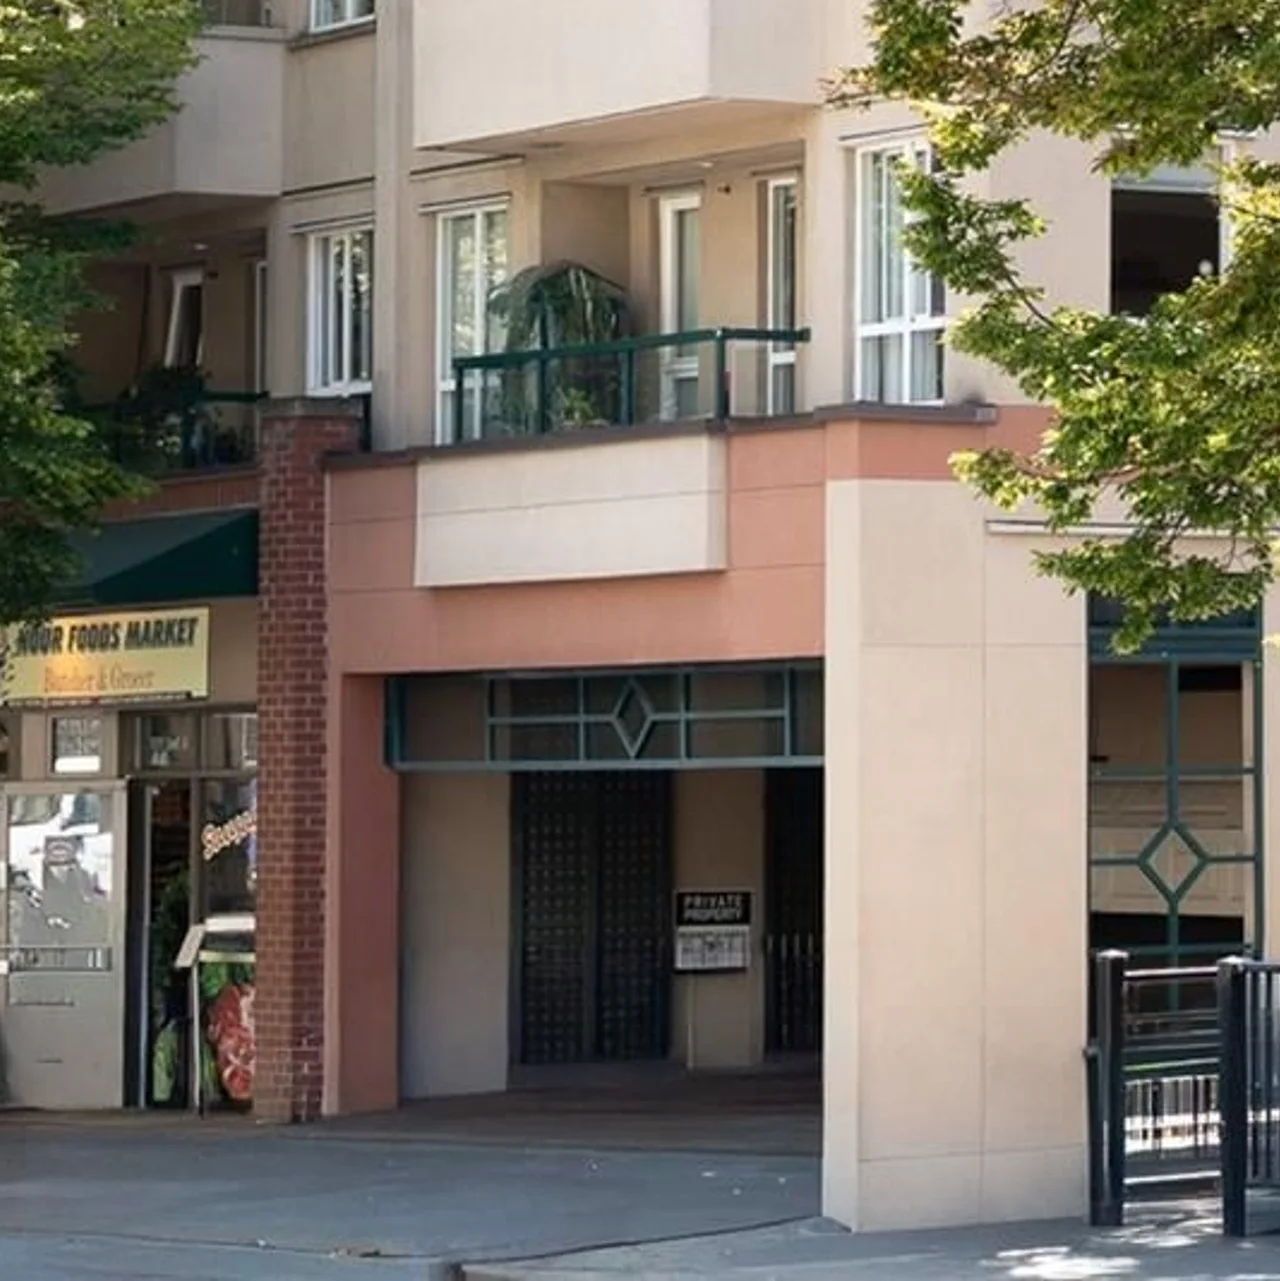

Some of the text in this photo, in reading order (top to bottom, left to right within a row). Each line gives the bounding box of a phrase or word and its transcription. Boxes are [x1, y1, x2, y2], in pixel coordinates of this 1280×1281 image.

[67, 621, 120, 652] FOODS
[124, 618, 198, 650] MARKET
[683, 894, 743, 908] PRIVATE
[683, 907, 743, 921] PROPERTY
